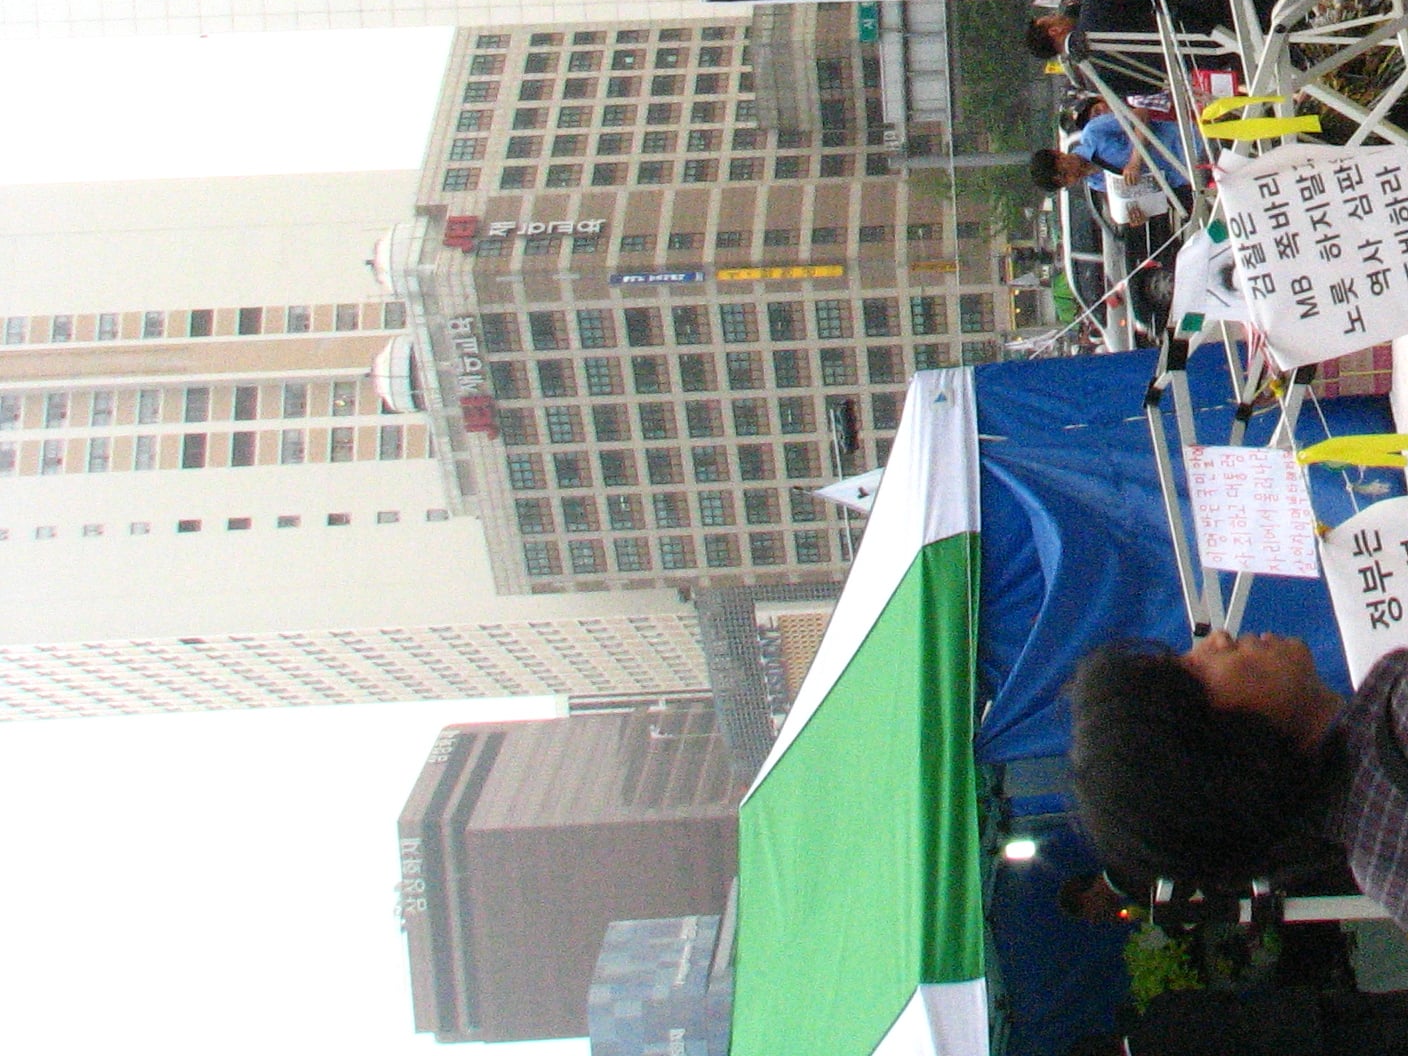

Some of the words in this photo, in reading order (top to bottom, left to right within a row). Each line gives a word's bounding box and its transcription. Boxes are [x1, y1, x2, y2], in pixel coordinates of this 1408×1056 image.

[1253, 171, 1300, 261] 쪽바리
[1229, 211, 1277, 300] 검찰은
[1356, 238, 1392, 297] 역사
[1290, 274, 1321, 321] MB
[1328, 277, 1367, 336] 노릇
[1351, 528, 1404, 630] 정부는
